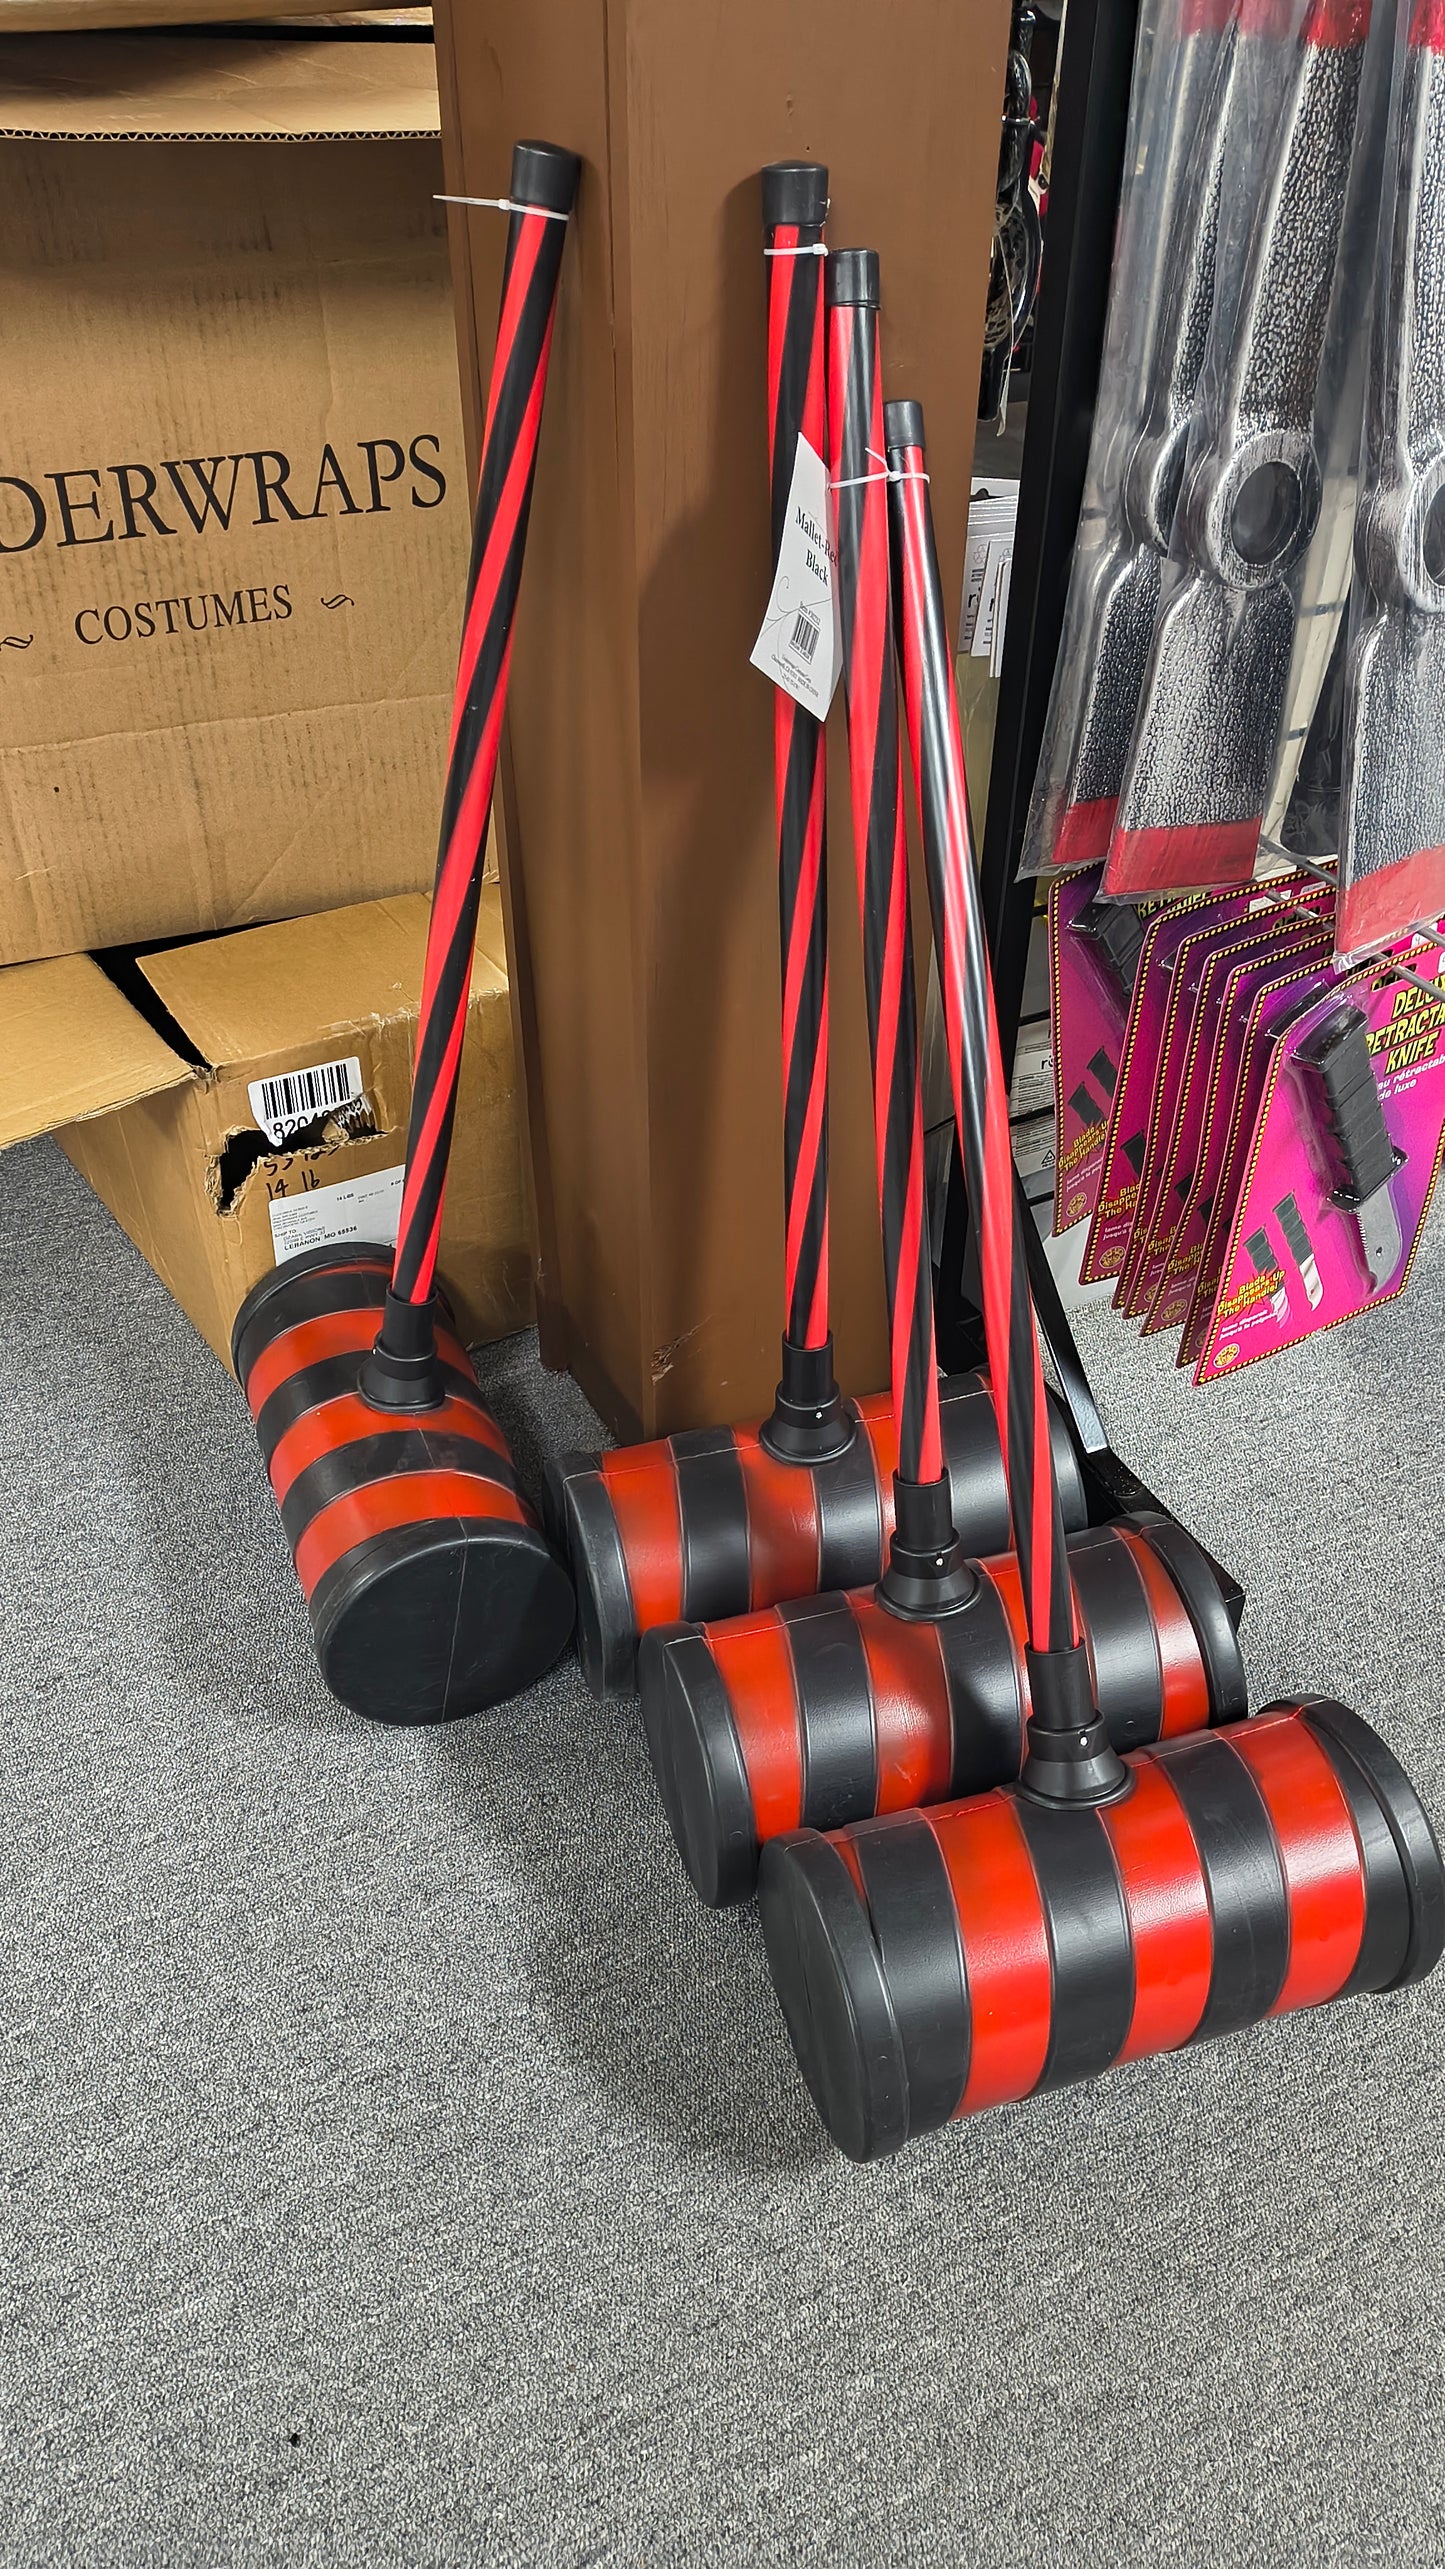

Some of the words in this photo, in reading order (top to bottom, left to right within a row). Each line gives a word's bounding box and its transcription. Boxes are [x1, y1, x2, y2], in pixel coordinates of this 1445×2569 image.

[0, 434, 446, 553] DERWRAPS
[806, 549, 828, 587] Black
[74, 584, 293, 645] COSTUMES
[1385, 1031, 1440, 1074] KNIFE
[1394, 1078, 1417, 1094] luxe
[1058, 1130, 1099, 1168] Disappears
[1101, 1120, 1108, 1130] U
[1073, 1126, 1095, 1148] Blade
[1064, 1159, 1078, 1171] The
[266, 1179, 289, 1201] 14
[1105, 1207, 1122, 1218] The
[1217, 1279, 1270, 1314] Disappears
[1272, 1270, 1286, 1281] Up
[1224, 1305, 1240, 1318] The
[1243, 1281, 1278, 1307] Handle!
[1239, 1275, 1266, 1295] Blade
